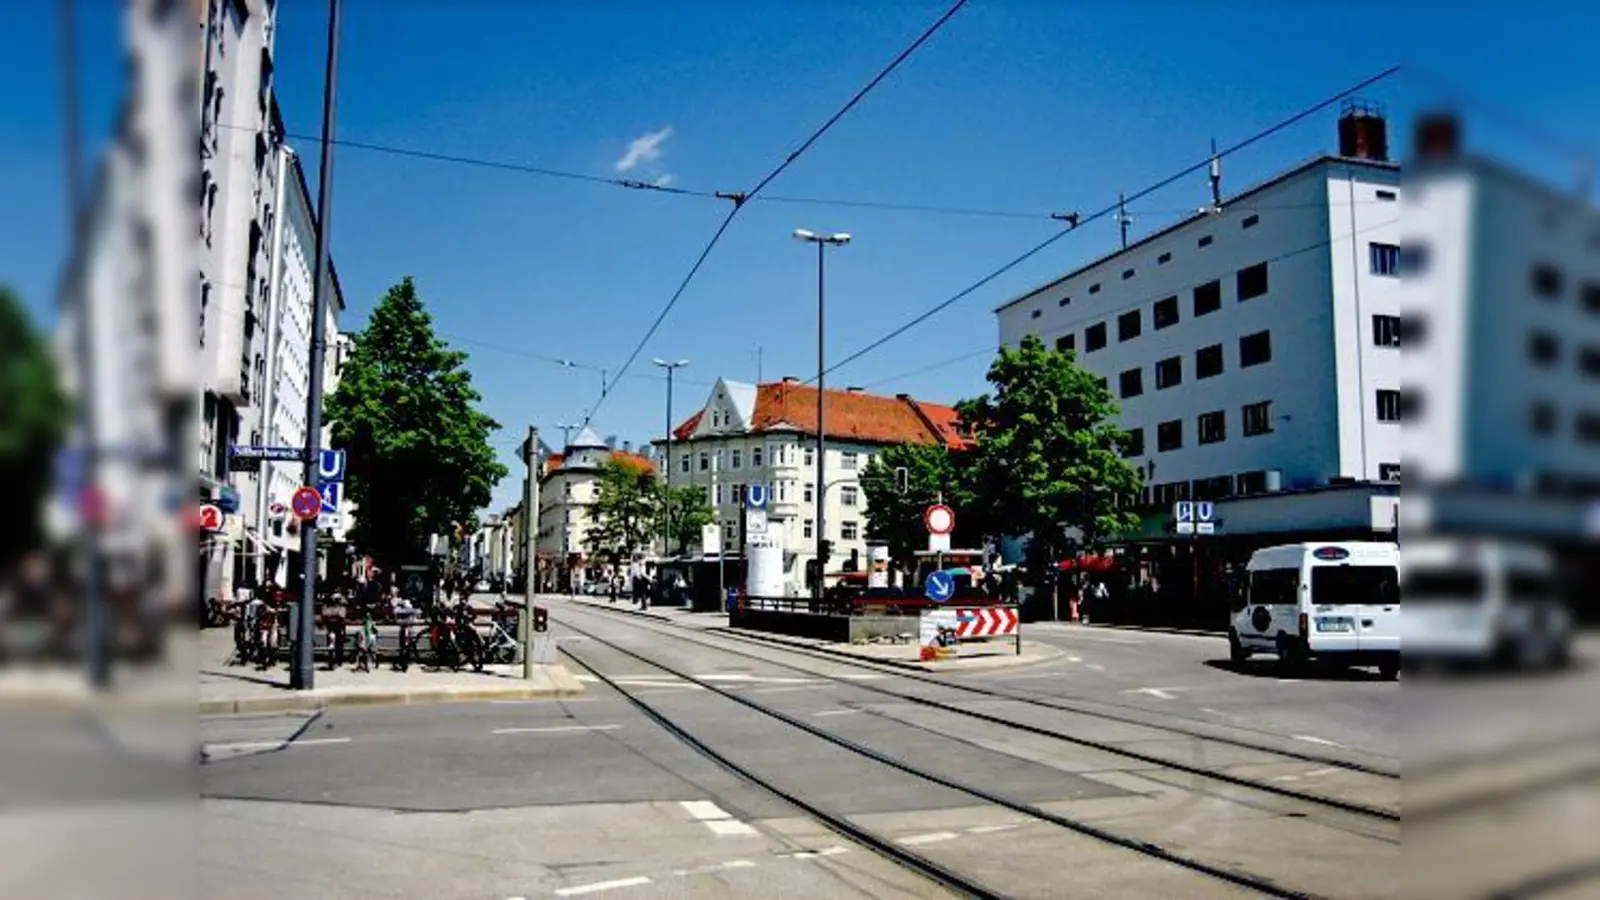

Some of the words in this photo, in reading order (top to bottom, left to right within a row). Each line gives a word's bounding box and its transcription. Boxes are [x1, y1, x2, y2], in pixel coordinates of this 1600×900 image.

[319, 451, 340, 478] U
[750, 486, 764, 506] U
[1199, 502, 1212, 520] U
